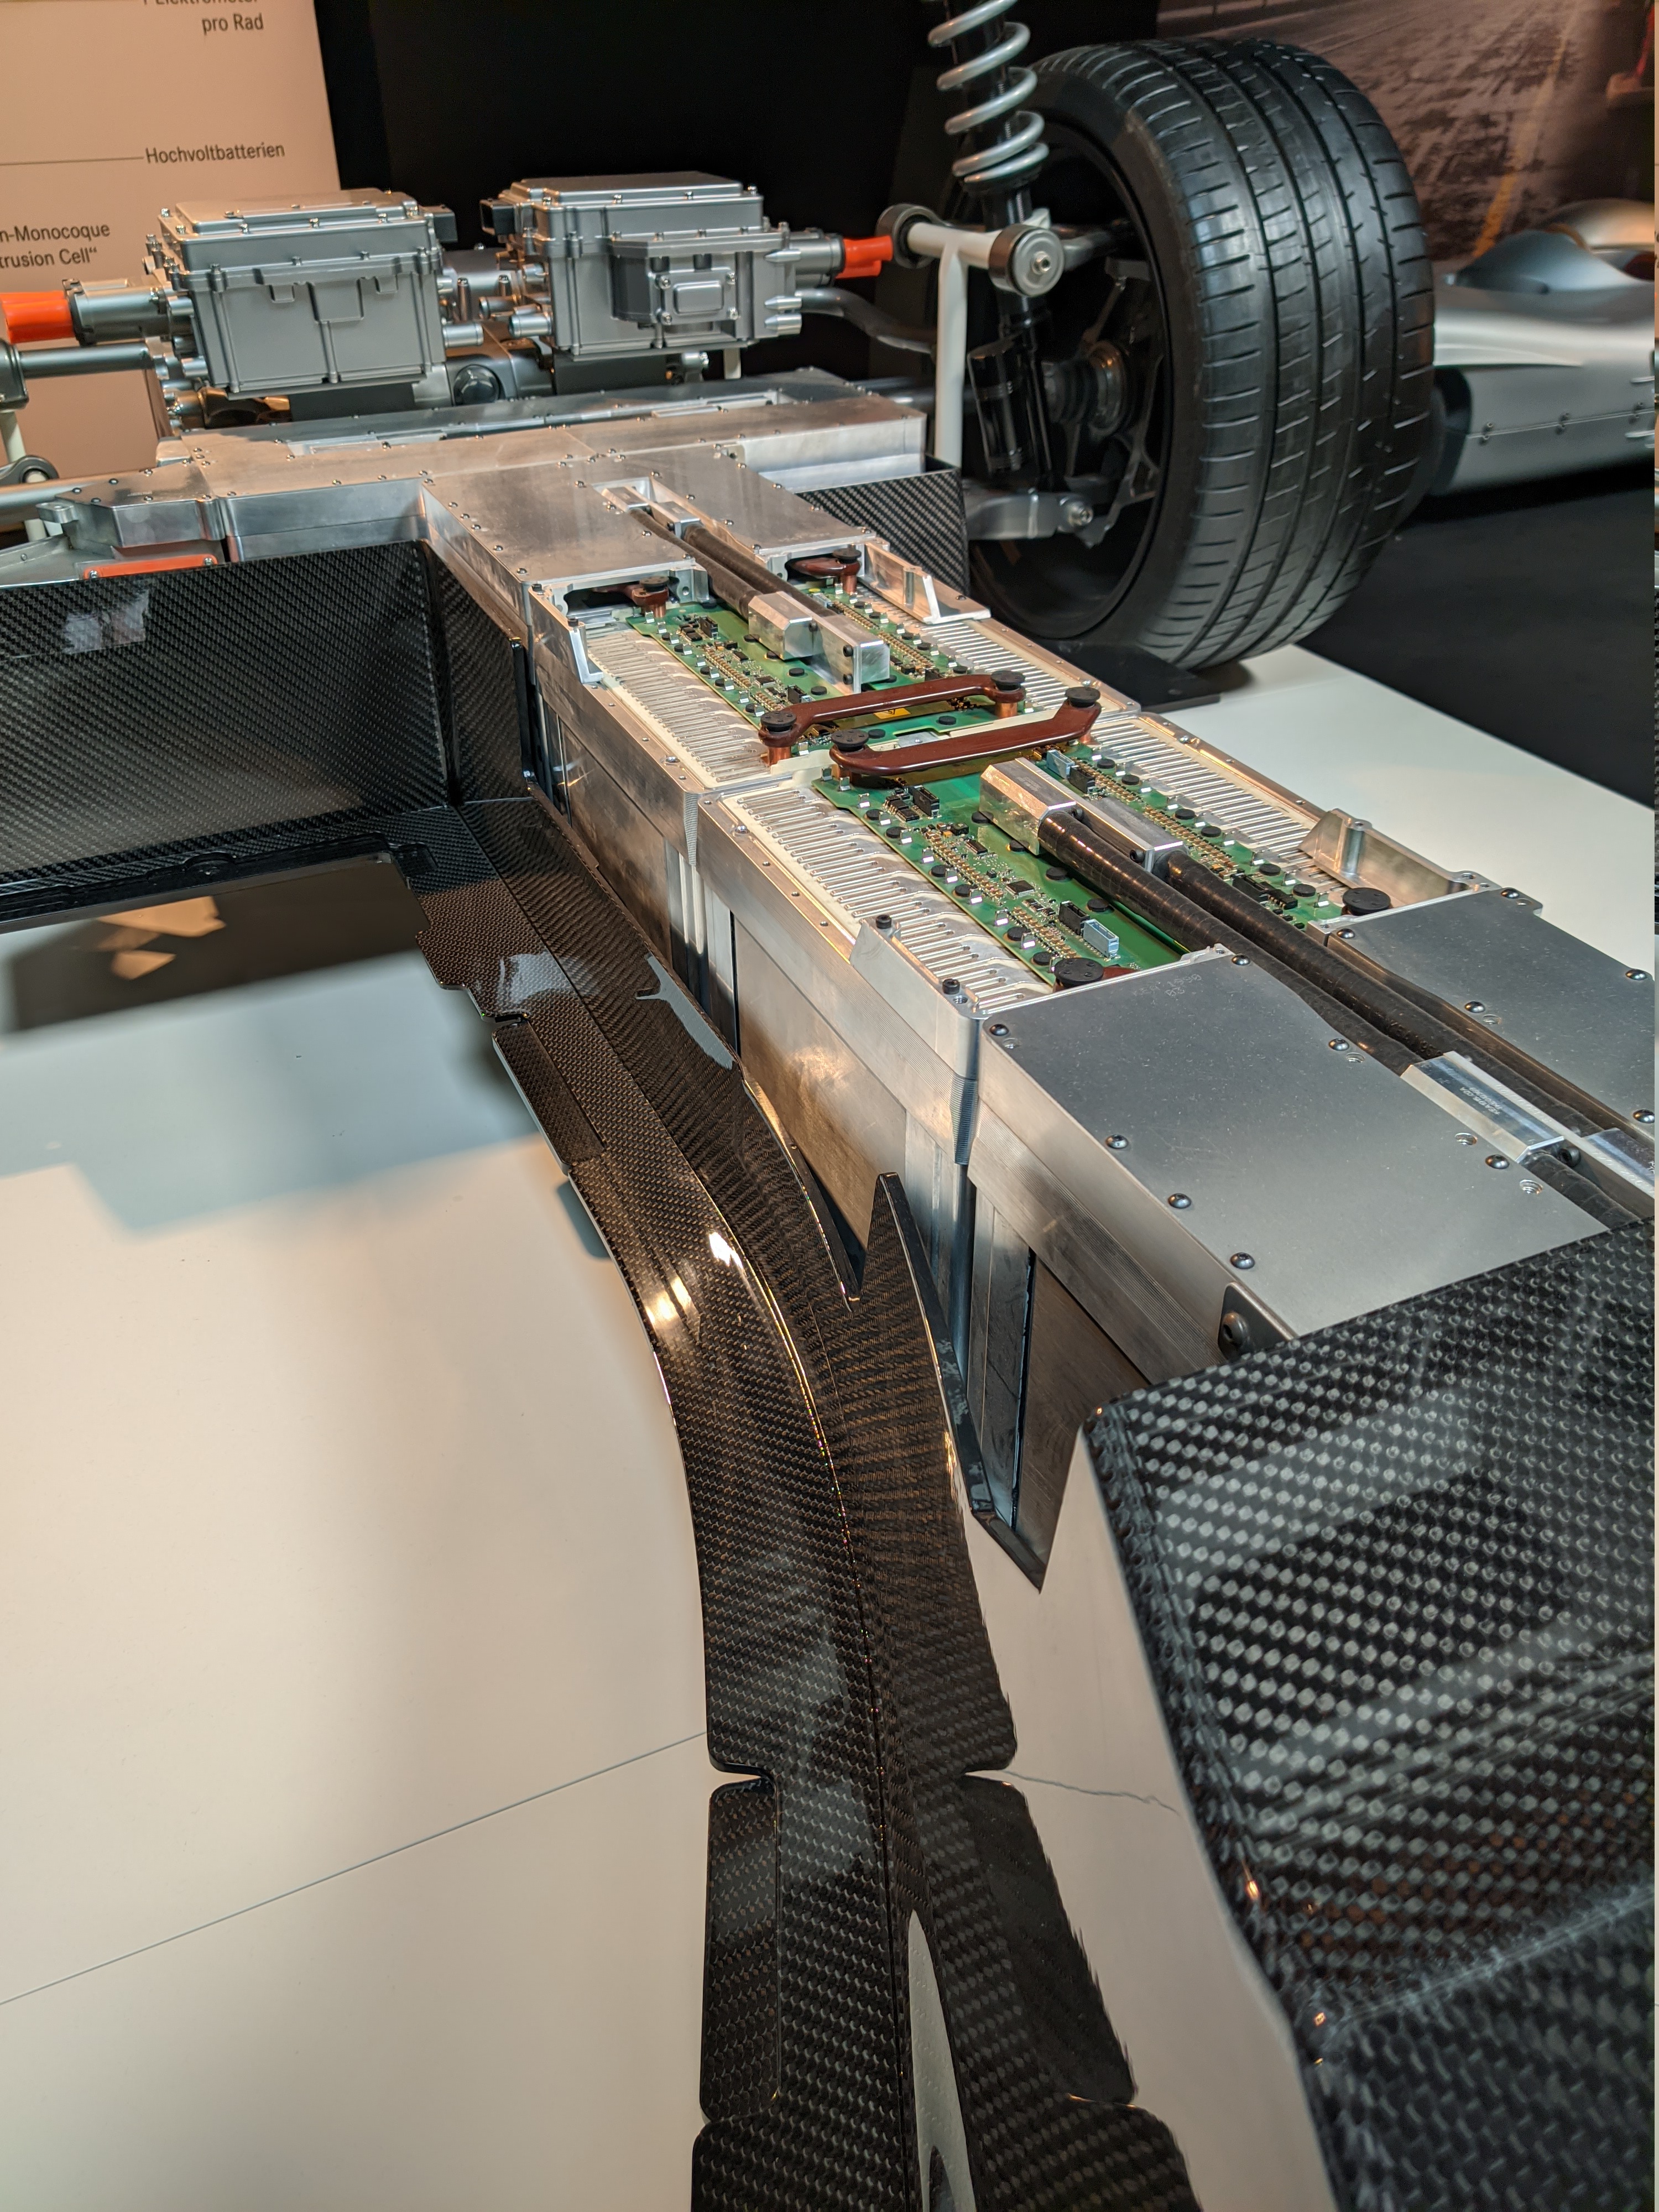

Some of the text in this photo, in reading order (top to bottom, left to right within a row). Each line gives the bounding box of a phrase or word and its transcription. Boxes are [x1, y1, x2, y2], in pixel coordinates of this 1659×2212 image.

[202, 13, 264, 35] pro Rad
[145, 142, 285, 164] Hochvoltbatterien
